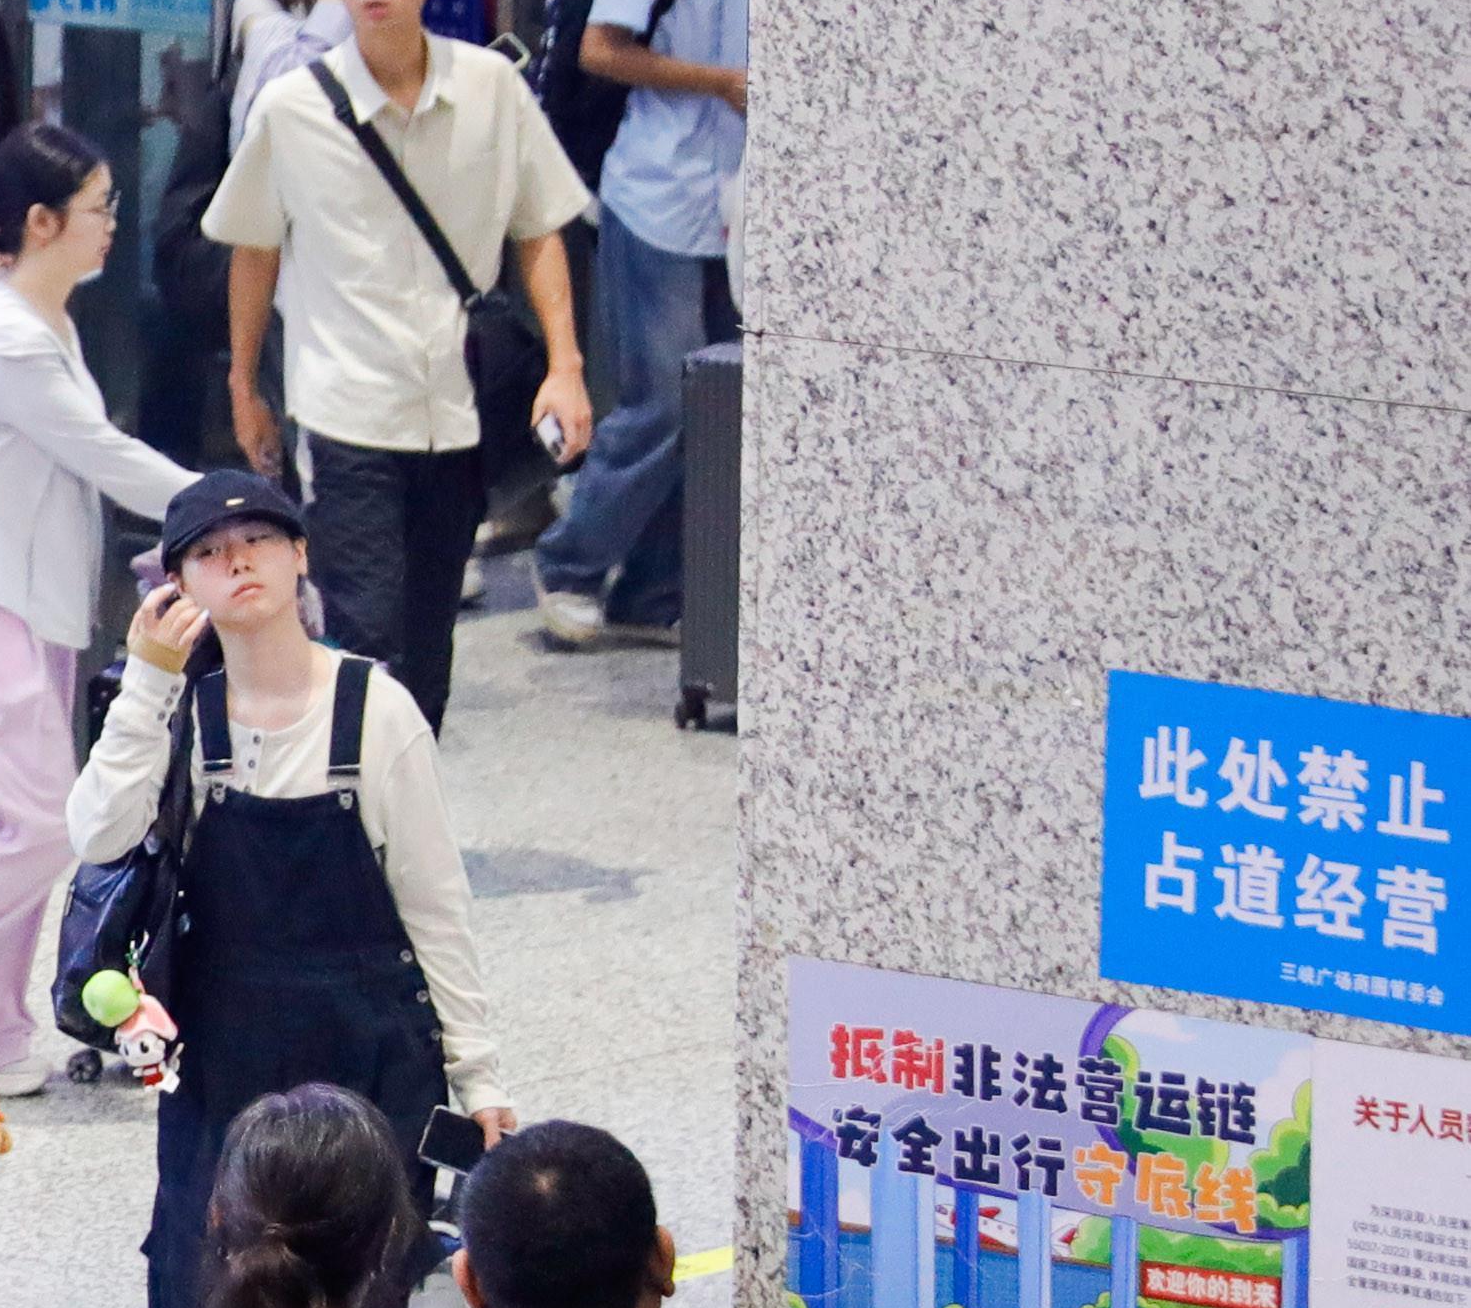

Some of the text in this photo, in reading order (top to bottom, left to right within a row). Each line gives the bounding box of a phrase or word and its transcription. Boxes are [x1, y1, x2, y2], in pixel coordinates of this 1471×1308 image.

[1138, 724, 1451, 845] 此处禁止
[1142, 831, 1450, 956] 占道经营
[829, 1022, 1257, 1148] 抵制非法营运链
[1353, 1094, 1471, 1144] 关于人员
[832, 1104, 1258, 1234] 安全出行守底线
